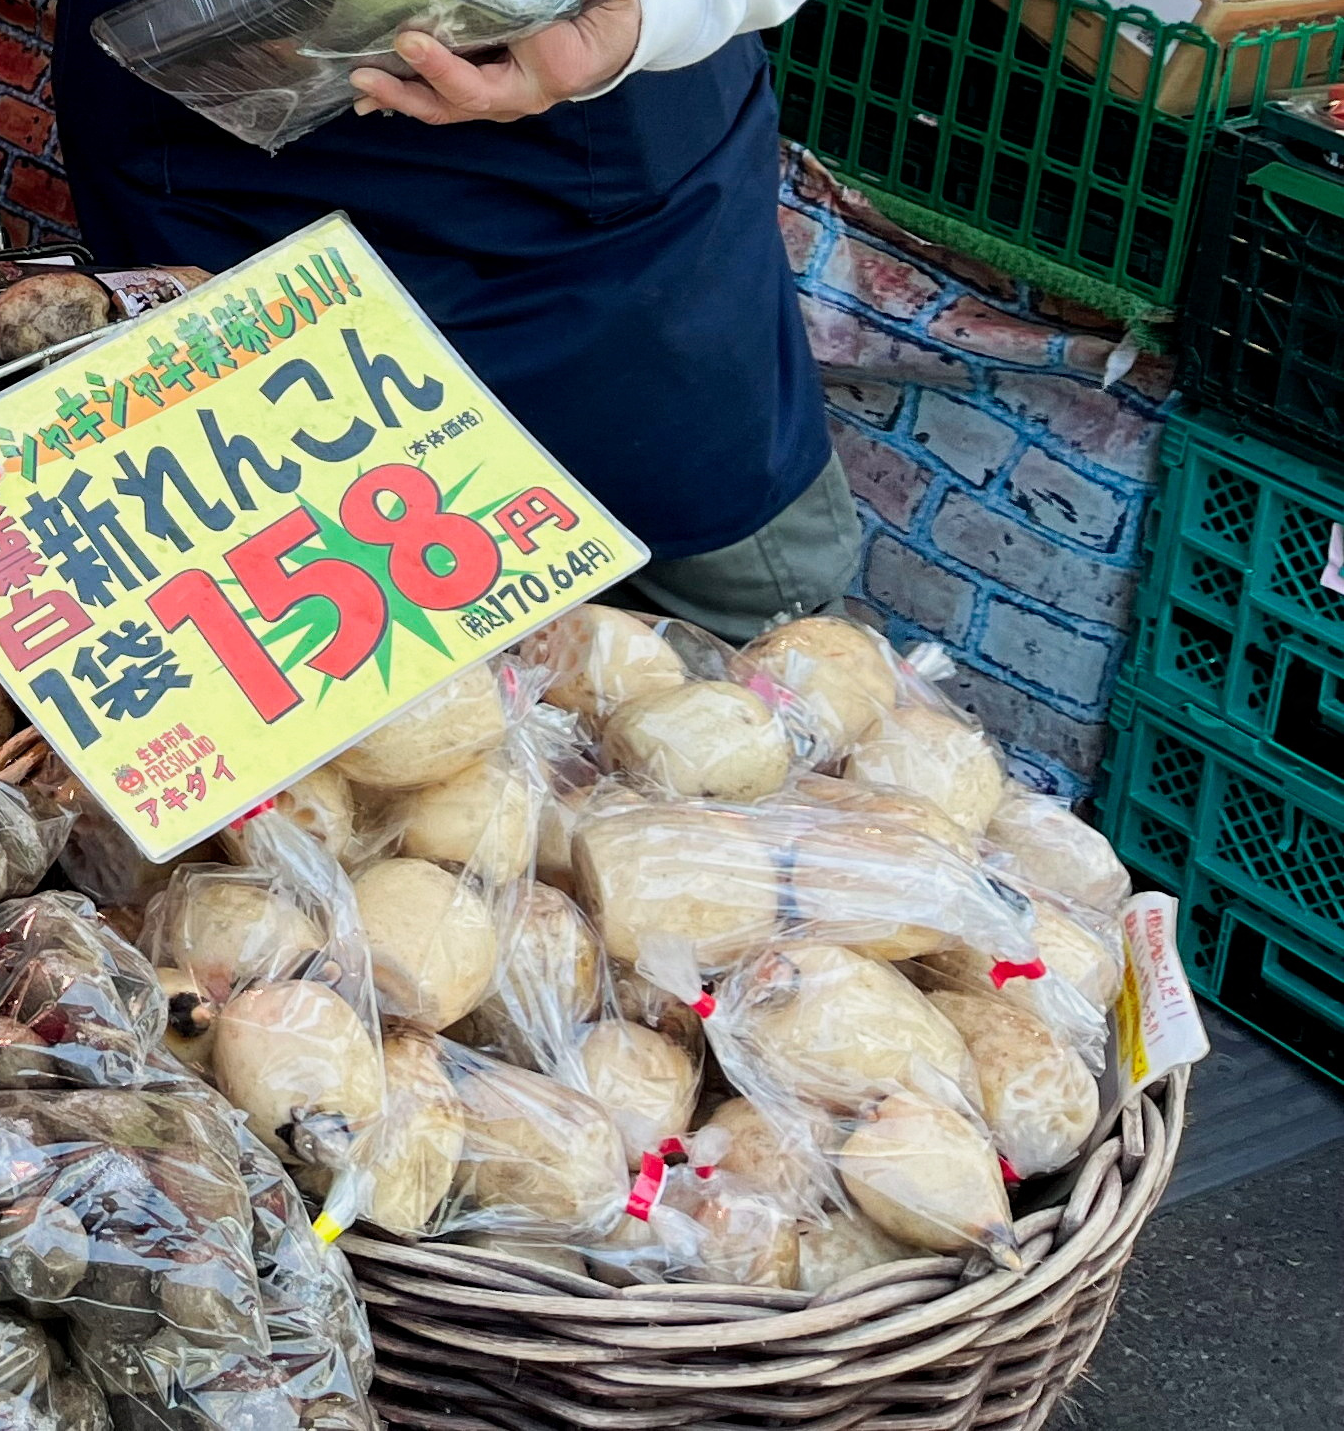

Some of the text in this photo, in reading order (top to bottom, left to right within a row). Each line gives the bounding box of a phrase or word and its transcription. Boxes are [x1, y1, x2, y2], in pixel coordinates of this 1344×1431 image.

[402, 406, 485, 462] (本体価格)
[22, 326, 446, 611] 新れんこん
[27, 462, 580, 752] 1袋 158 円
[133, 721, 194, 769] 生鮮市場
[142, 733, 218, 787] FRESHLAND
[134, 751, 238, 830] アキダイ
